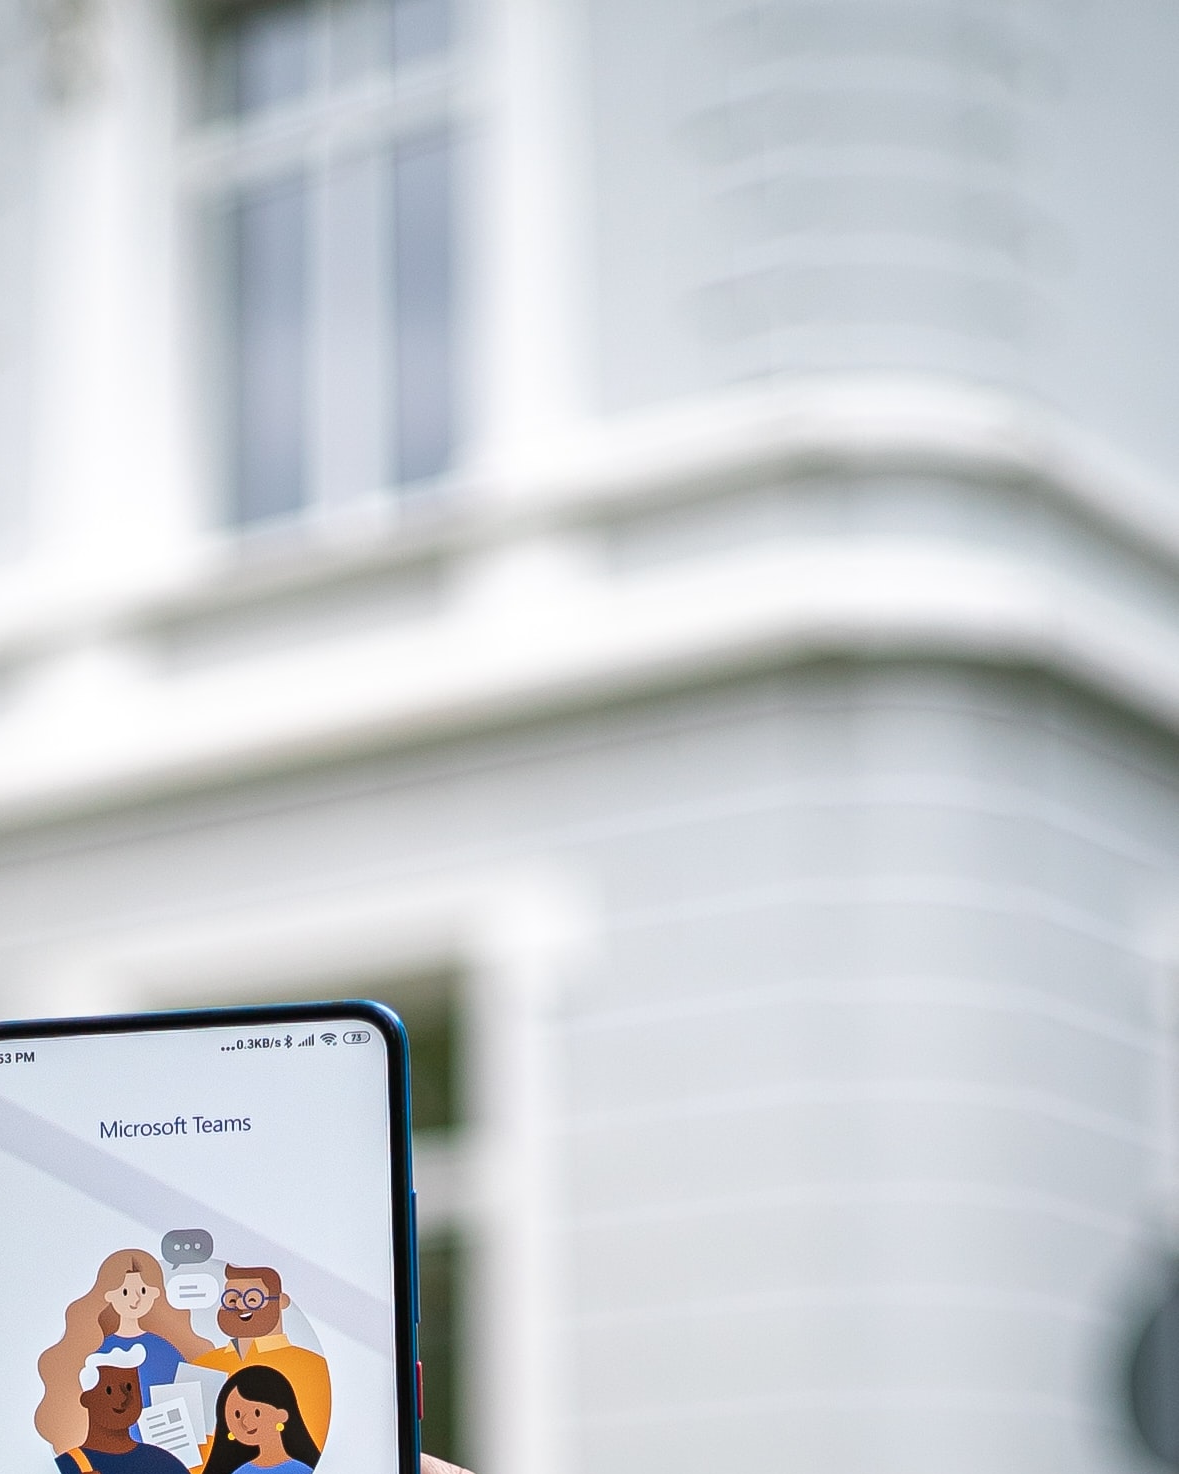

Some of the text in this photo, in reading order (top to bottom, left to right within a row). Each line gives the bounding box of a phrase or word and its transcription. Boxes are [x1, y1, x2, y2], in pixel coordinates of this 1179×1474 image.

[15, 1051, 35, 1063] PM
[99, 1115, 252, 1139] Microsoft Teams
